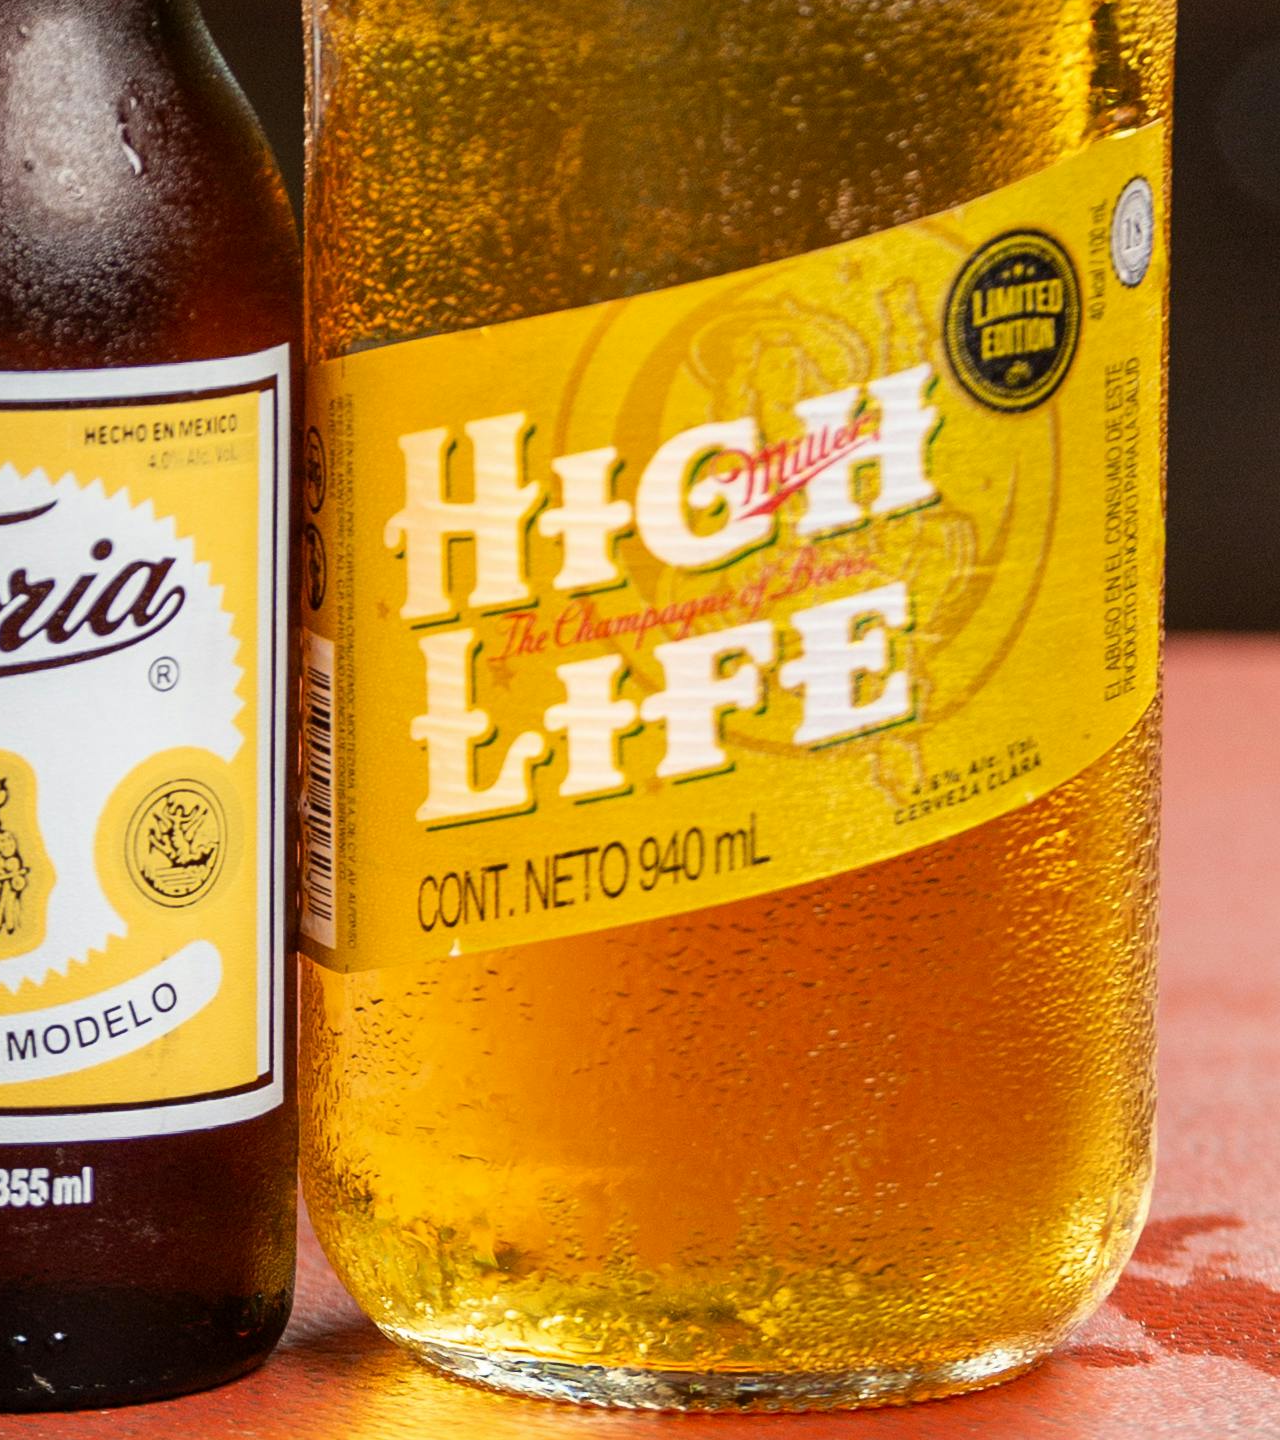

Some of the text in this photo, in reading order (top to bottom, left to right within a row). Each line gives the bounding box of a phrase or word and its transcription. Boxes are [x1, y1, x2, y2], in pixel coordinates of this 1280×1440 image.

[972, 278, 1064, 328] LIMITED
[981, 317, 1056, 361] EDITION
[1104, 360, 1124, 412] ESTE
[84, 413, 238, 445] HECHO EN MEXICO
[1104, 418, 1123, 443] DE
[383, 363, 941, 623] HIGH
[711, 413, 881, 521] Miller
[1104, 446, 1122, 545] CONSUMO
[1104, 576, 1122, 603] EN
[488, 613, 548, 665] The
[553, 591, 737, 650] Champagne
[1104, 607, 1122, 671] ABUSO
[410, 582, 915, 825] LIFE
[894, 783, 981, 825] CERVEZA
[418, 811, 771, 932] CONT. NETO 940 mL
[6, 983, 178, 1061] MODELO
[52, 1167, 93, 1205] ml
